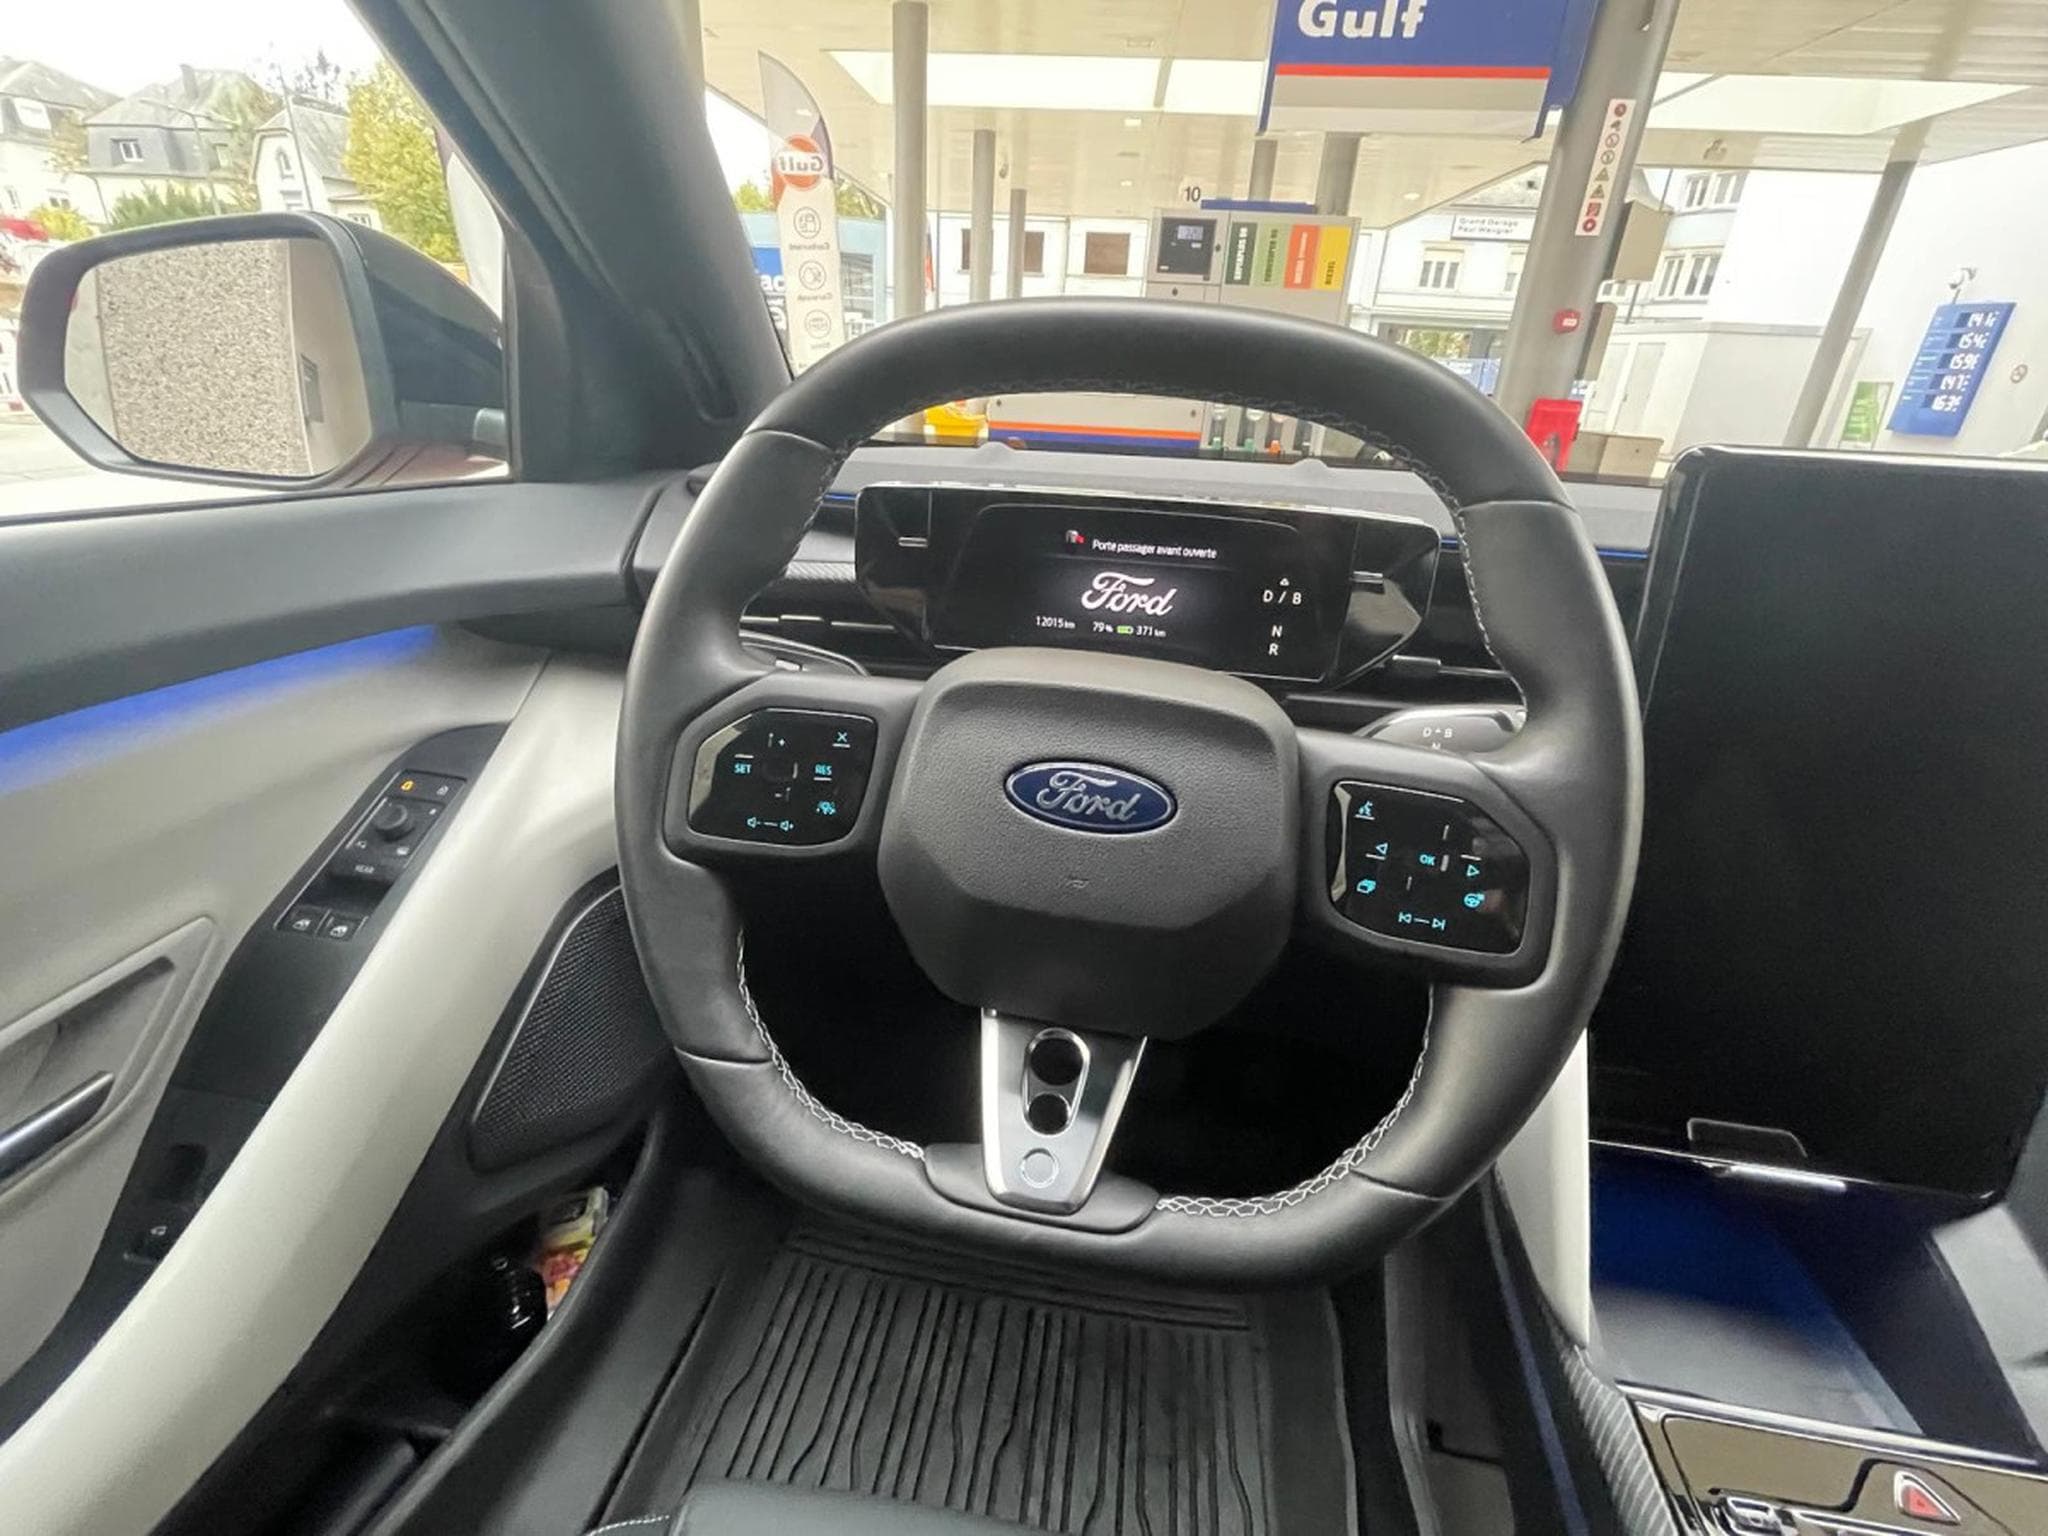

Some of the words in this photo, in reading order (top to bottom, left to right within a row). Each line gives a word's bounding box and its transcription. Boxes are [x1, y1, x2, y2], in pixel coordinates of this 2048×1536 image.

[1298, 0, 1428, 38] Gulf
[1185, 186, 1201, 201] 10
[1092, 539, 1116, 552] Porte
[1117, 543, 1156, 556] passager
[1156, 545, 1182, 557] avant
[1182, 547, 1218, 559] ouverte
[1081, 572, 1177, 616] Ford
[1262, 590, 1273, 603] D
[1292, 592, 1302, 605] B
[1271, 625, 1283, 638] N
[1268, 643, 1279, 656] R
[733, 763, 752, 774] SET
[814, 764, 832, 776] RES
[1036, 770, 1141, 821] Ford
[1419, 854, 1435, 866] OK
